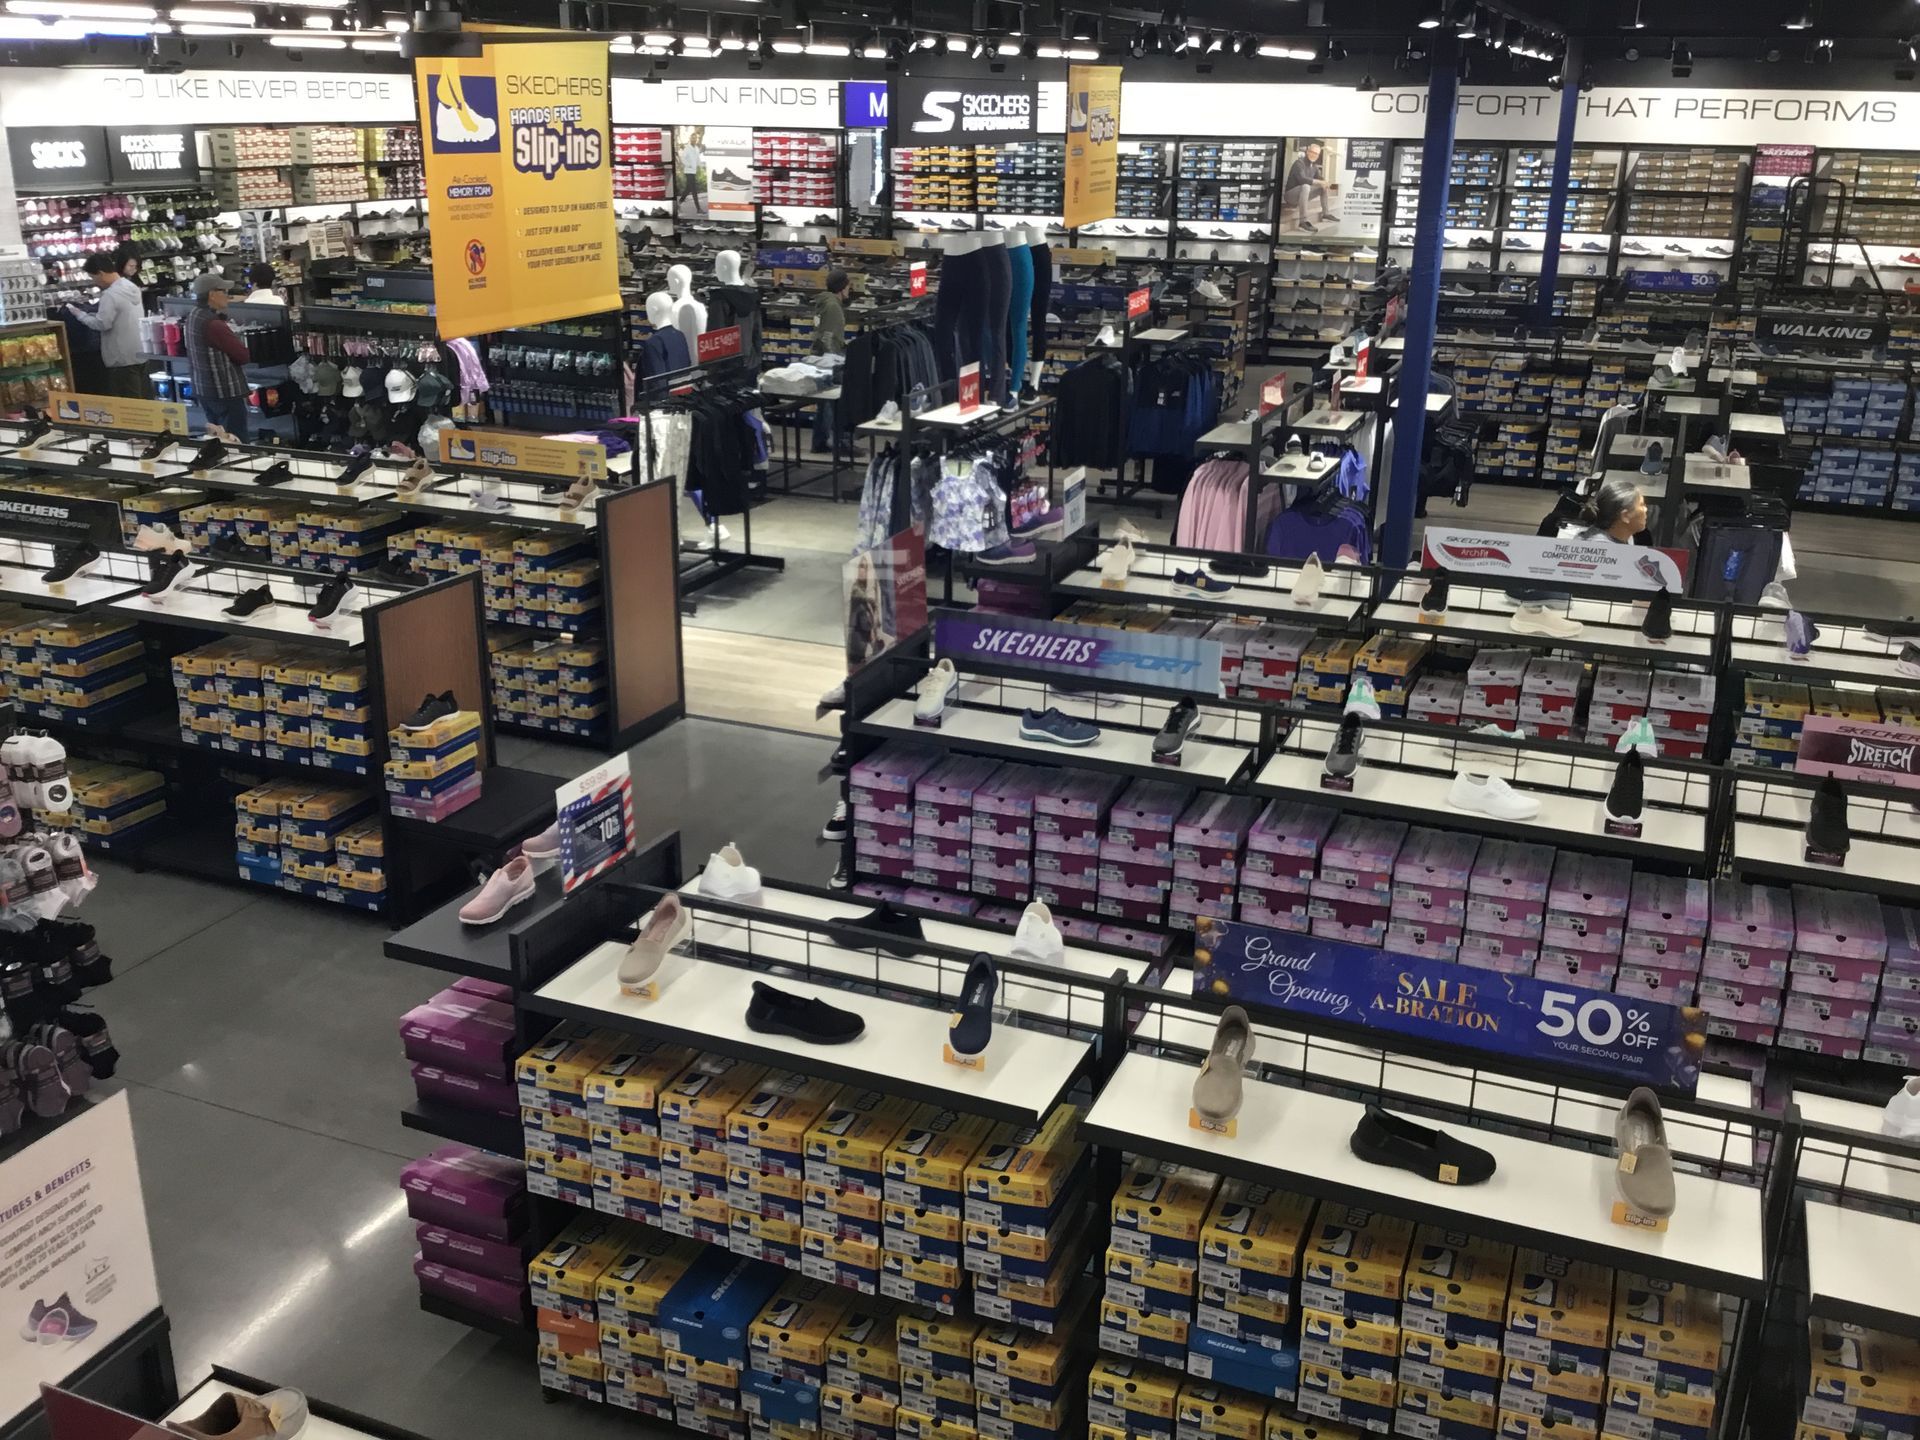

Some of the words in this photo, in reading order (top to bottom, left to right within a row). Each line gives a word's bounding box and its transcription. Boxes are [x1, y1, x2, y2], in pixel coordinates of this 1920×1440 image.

[155, 78, 209, 98] LIKE
[218, 79, 298, 98] NEVER
[307, 81, 390, 100] BEFORE
[506, 74, 603, 96] SKECHERS
[676, 86, 728, 104] FUN
[739, 87, 817, 106] FINDS
[962, 94, 1030, 116] SKECHERS
[510, 107, 551, 125] HANDS
[553, 105, 582, 122] FREE
[1371, 93, 1550, 116] COFORT
[1674, 98, 1897, 122] PERFORMS
[30, 142, 86, 168] SOCKS
[514, 124, 601, 177] Slip-ins
[126, 152, 154, 170] YOUR
[449, 188, 474, 198] MEMORY
[474, 186, 491, 196] FOAM
[523, 206, 550, 216] DESIGNED
[550, 205, 557, 214] TO
[558, 204, 570, 213] SLIP
[578, 202, 596, 210] HANDS
[525, 228, 538, 236] JUST
[538, 226, 552, 235] STEP
[560, 224, 570, 232] AND
[526, 246, 553, 258] EXCLUSIVE
[1453, 307, 1506, 315] SKECHERS
[1772, 323, 1872, 340] WALKING
[700, 337, 720, 352] SALE
[480, 450, 517, 465] Slip-ins
[60, 520, 90, 530] COMPANY
[1446, 535, 1511, 547] SKECHERS
[1554, 544, 1568, 552] THE
[1570, 546, 1608, 556] ULTIMATE
[1542, 552, 1578, 562] COMFORT
[1580, 554, 1617, 565] SOLUTION
[972, 628, 1097, 664] SKECHERS
[1847, 738, 1916, 772] STRETCH
[1241, 936, 1317, 972] Grand
[1268, 969, 1352, 1016] Opening
[1396, 971, 1478, 1009] SALE
[1370, 992, 1500, 1033] A-BRATION
[1622, 1032, 1659, 1050] OFF
[1552, 1040, 1578, 1053] YOUR
[1581, 1045, 1620, 1060] SECOND
[1622, 1054, 1644, 1064] PAIR
[34, 1190, 42, 1201] &
[45, 1158, 92, 1194] BENEFITS
